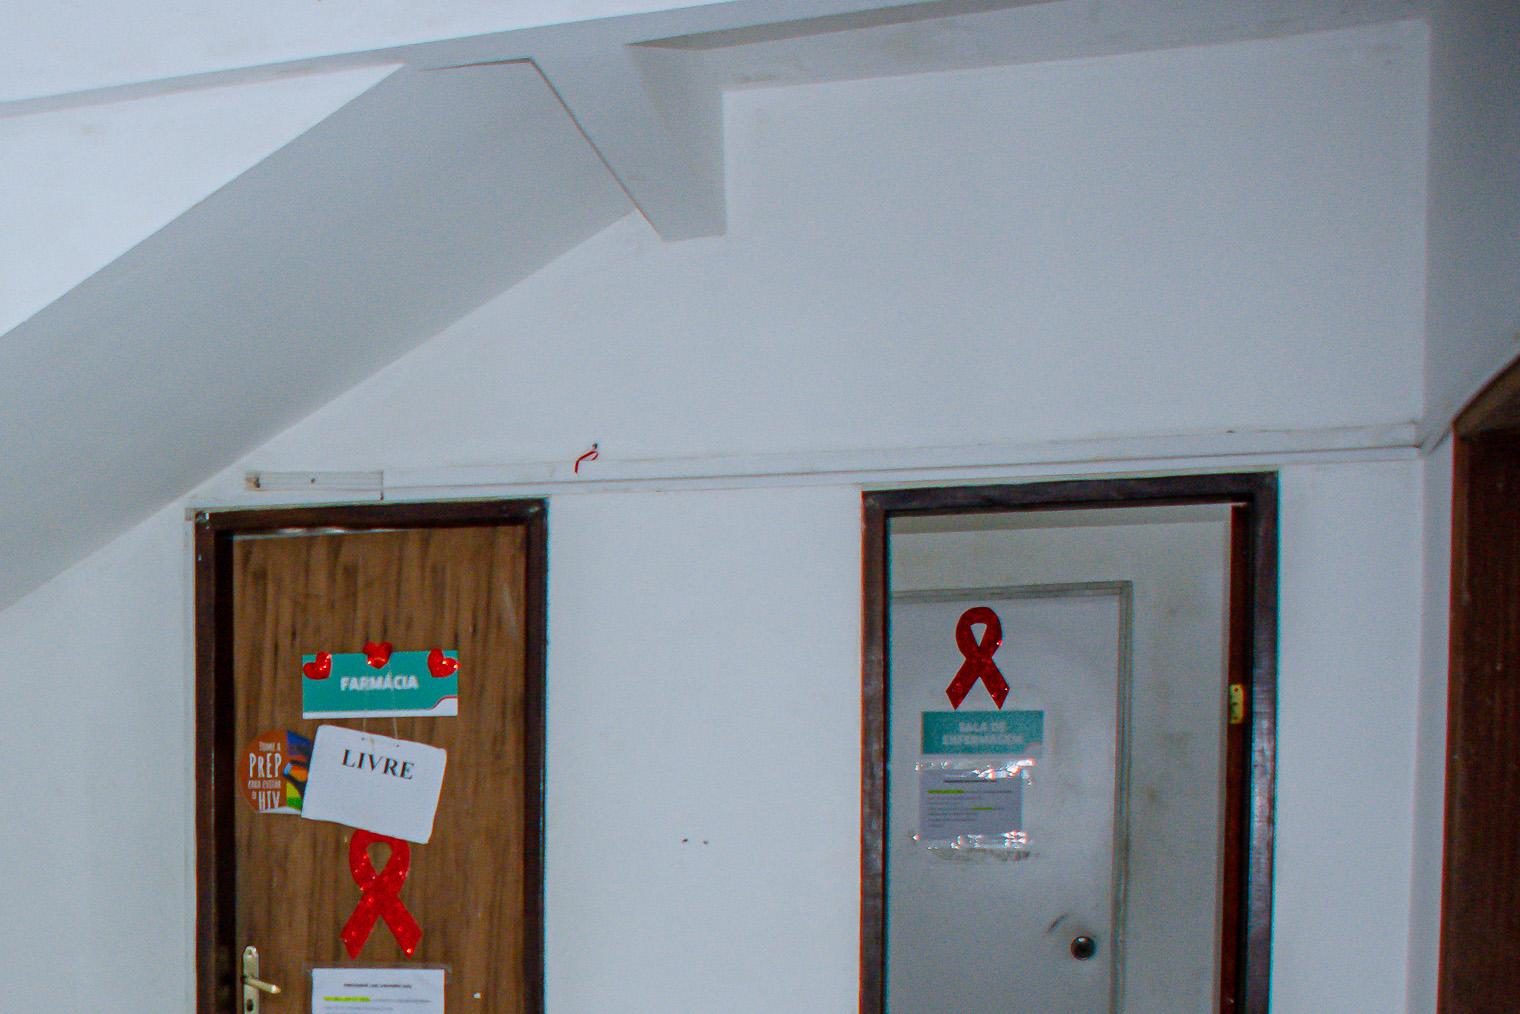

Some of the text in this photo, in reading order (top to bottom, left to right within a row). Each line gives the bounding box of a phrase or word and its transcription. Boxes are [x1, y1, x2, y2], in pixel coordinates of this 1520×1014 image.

[340, 672, 419, 691] FARMÁCIA
[341, 749, 415, 780] LIVRE
[259, 790, 280, 811] HIV
